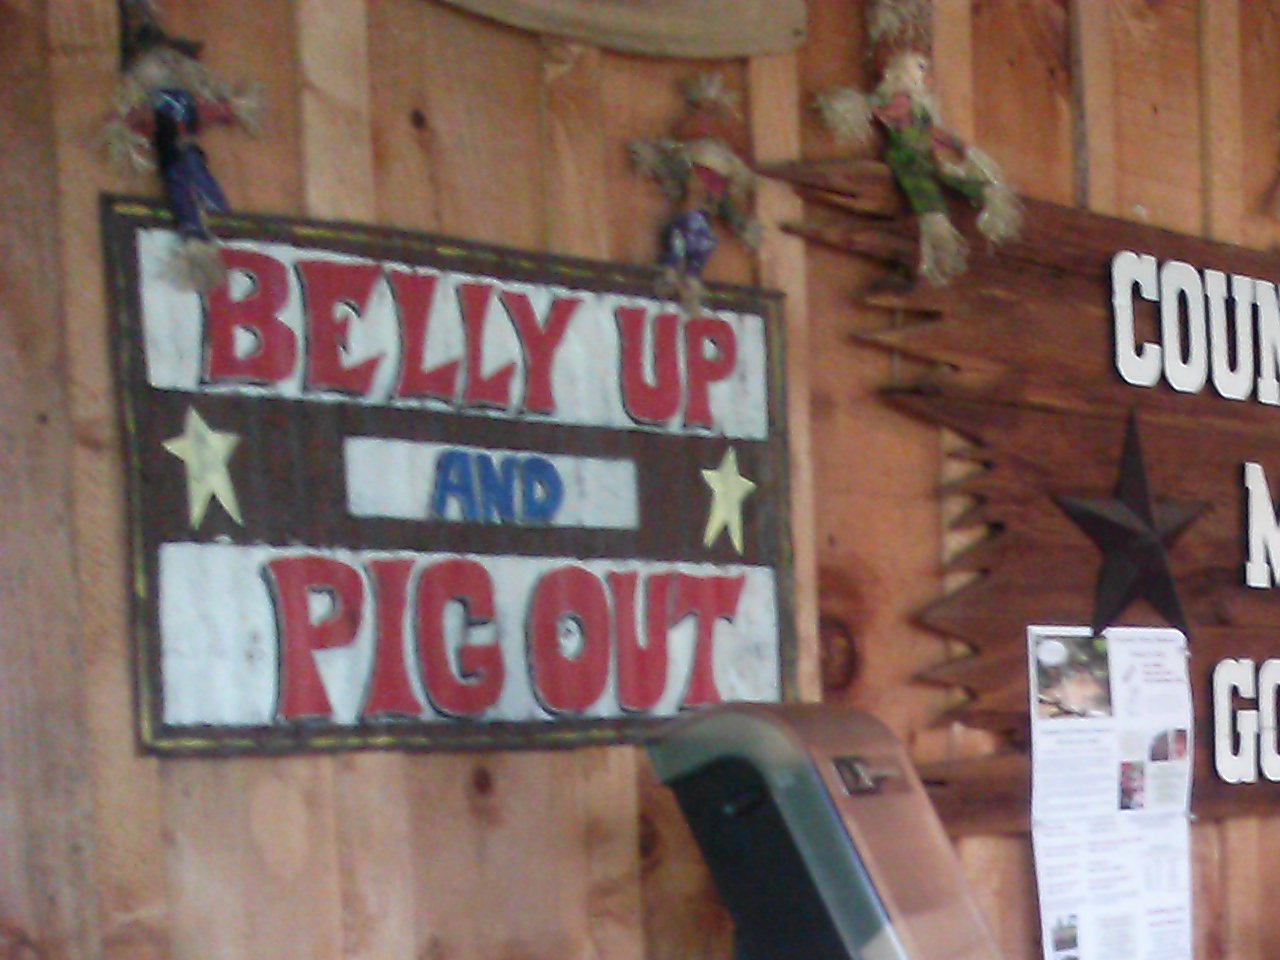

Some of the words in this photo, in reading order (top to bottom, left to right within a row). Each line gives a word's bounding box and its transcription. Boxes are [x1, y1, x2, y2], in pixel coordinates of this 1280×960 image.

[202, 247, 581, 415] BELLY
[614, 304, 738, 428] UP
[430, 447, 566, 524] AND
[262, 556, 503, 720] PIG
[525, 564, 746, 717] OUT
